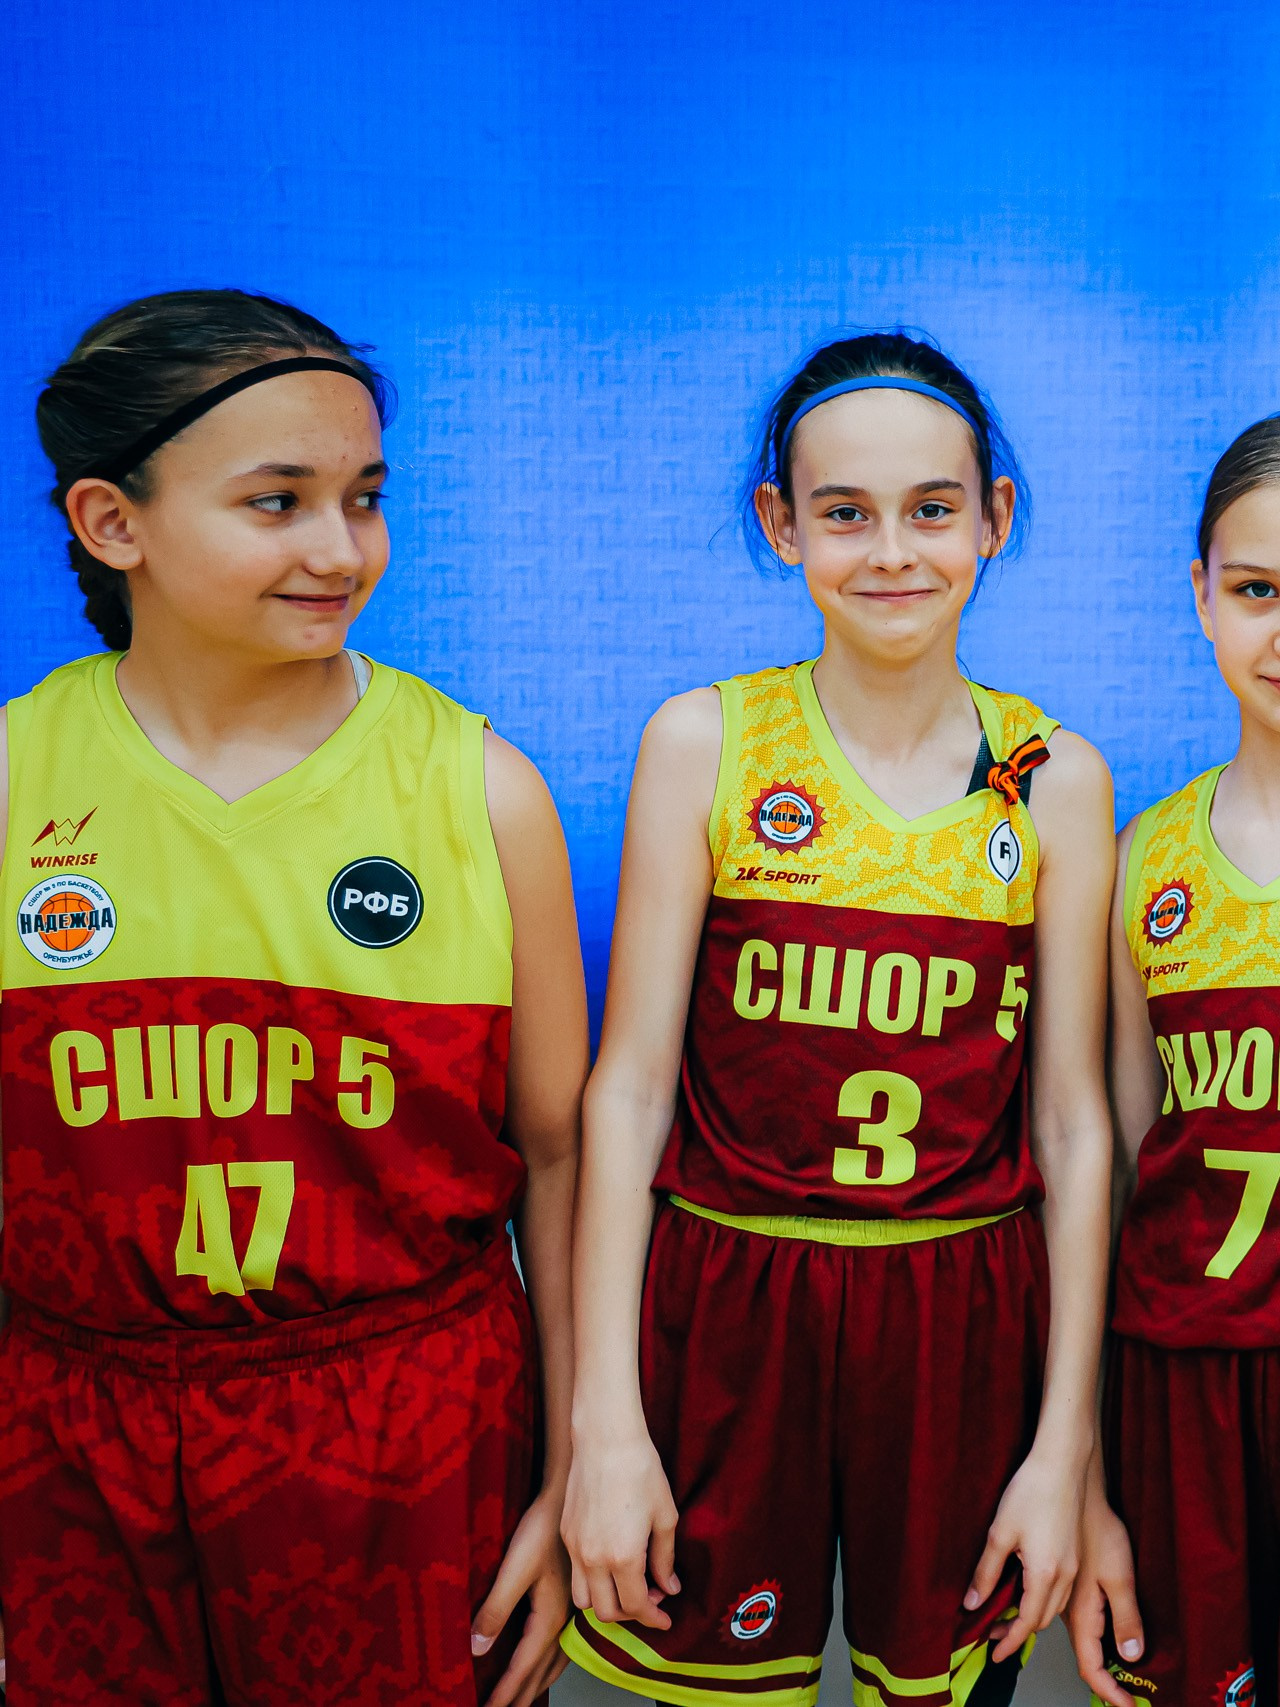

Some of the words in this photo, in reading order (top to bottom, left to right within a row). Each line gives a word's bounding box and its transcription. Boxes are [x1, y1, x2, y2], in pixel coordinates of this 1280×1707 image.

[30, 853, 98, 869] WINRISE
[735, 867, 764, 881] 2K
[763, 870, 822, 885] SPORT
[343, 887, 410, 917] РФБ
[18, 906, 114, 935] НАДЕЖДА
[1153, 961, 1189, 978] SPORT
[733, 939, 976, 1036] СШОР
[996, 965, 1029, 1043] 5
[50, 1023, 314, 1127] СШОР
[337, 1036, 395, 1129] 5
[832, 1070, 922, 1186] 3
[175, 1161, 295, 1296] 47
